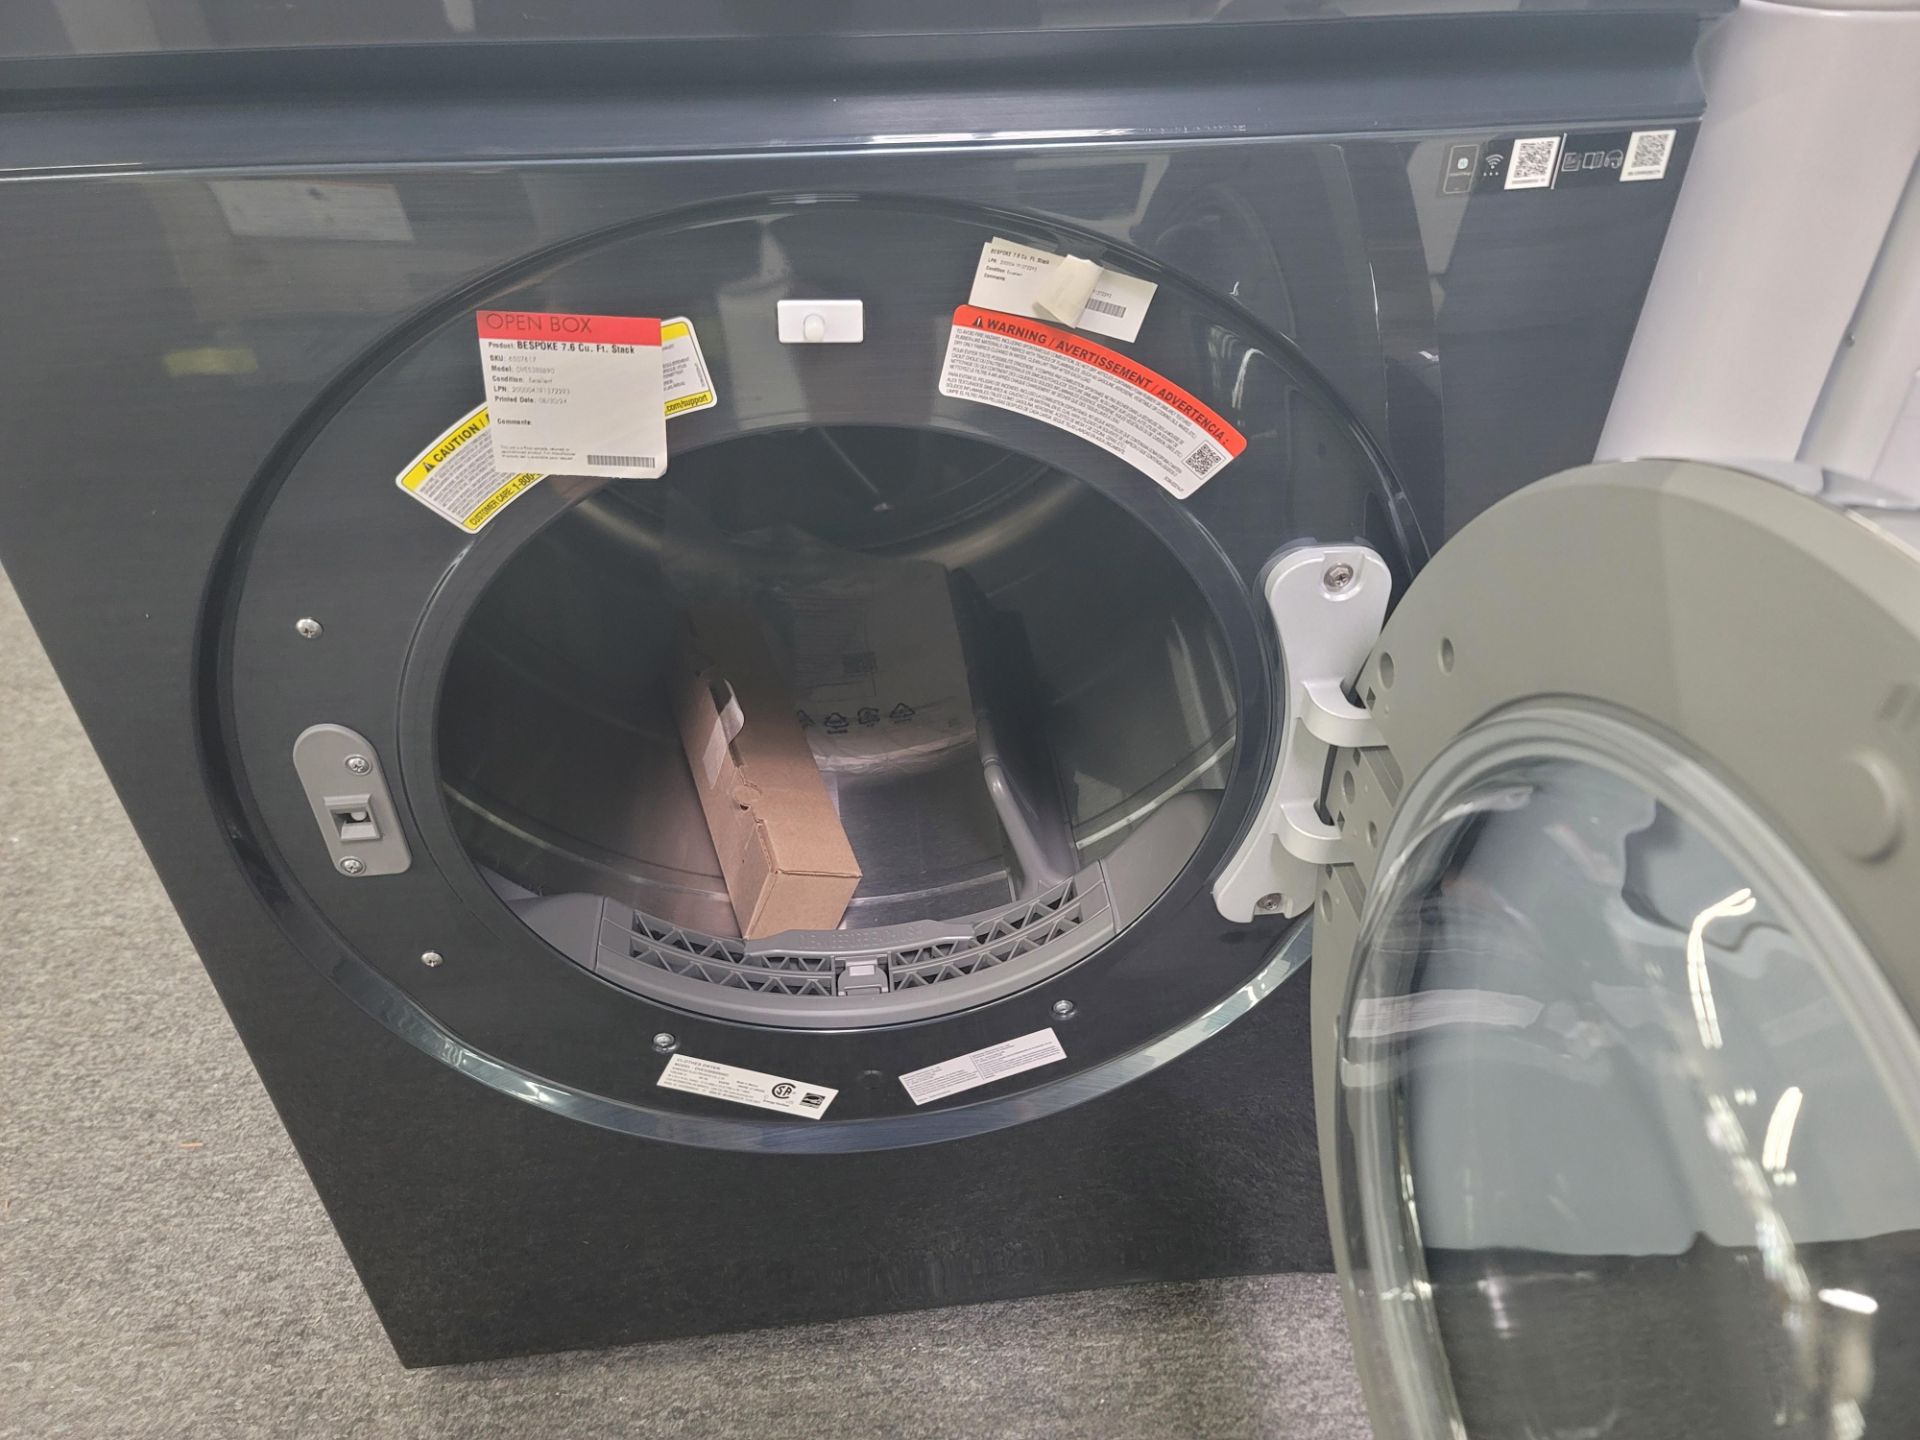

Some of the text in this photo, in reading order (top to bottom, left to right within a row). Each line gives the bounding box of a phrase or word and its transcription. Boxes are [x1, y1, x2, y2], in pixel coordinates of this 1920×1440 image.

[486, 313, 593, 334] OPEN BOX
[517, 341, 558, 352] BESPOKE
[561, 343, 576, 352] 7.6
[578, 343, 593, 353] Cu.
[596, 344, 608, 353] Ft.
[611, 344, 635, 354] Stack
[987, 318, 1048, 345] WARNING
[1056, 340, 1153, 388] AVERTISSEMENT
[495, 395, 517, 403] Printed
[432, 423, 480, 463] CAUTION
[469, 498, 499, 526] CUSTOMER
